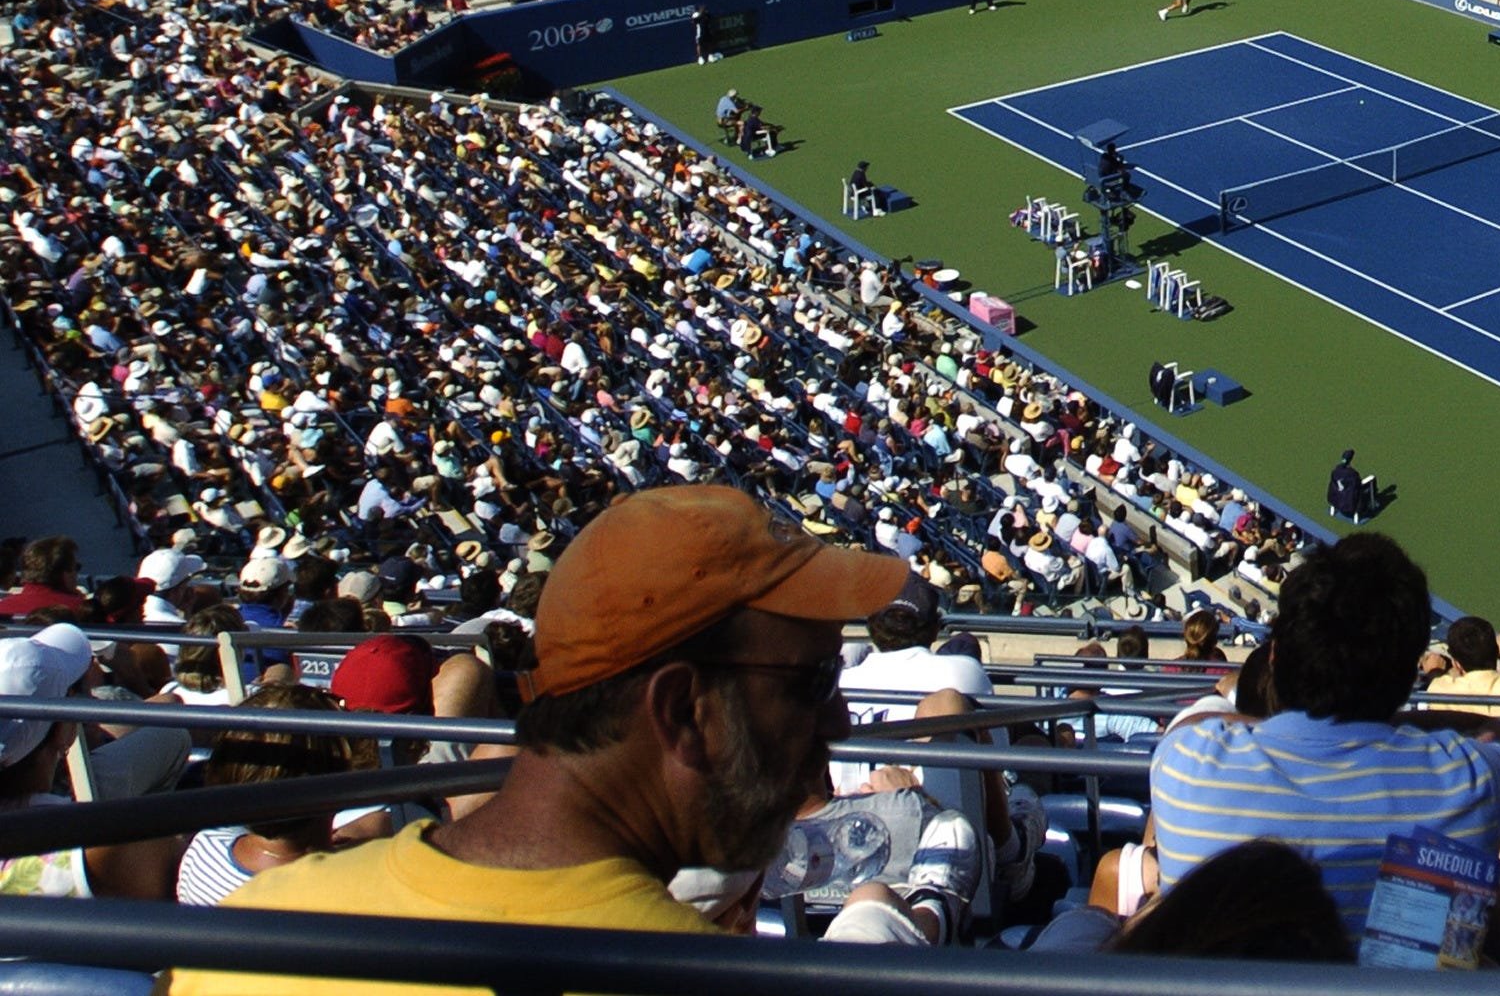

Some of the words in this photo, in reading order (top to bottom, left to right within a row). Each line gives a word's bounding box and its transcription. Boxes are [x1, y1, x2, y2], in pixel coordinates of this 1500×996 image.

[527, 20, 592, 51] 2005
[625, 5, 696, 27] OLYMPUS
[302, 659, 330, 675] 213
[1418, 847, 1482, 880] SCHEDULE
[1485, 864, 1495, 883] &
